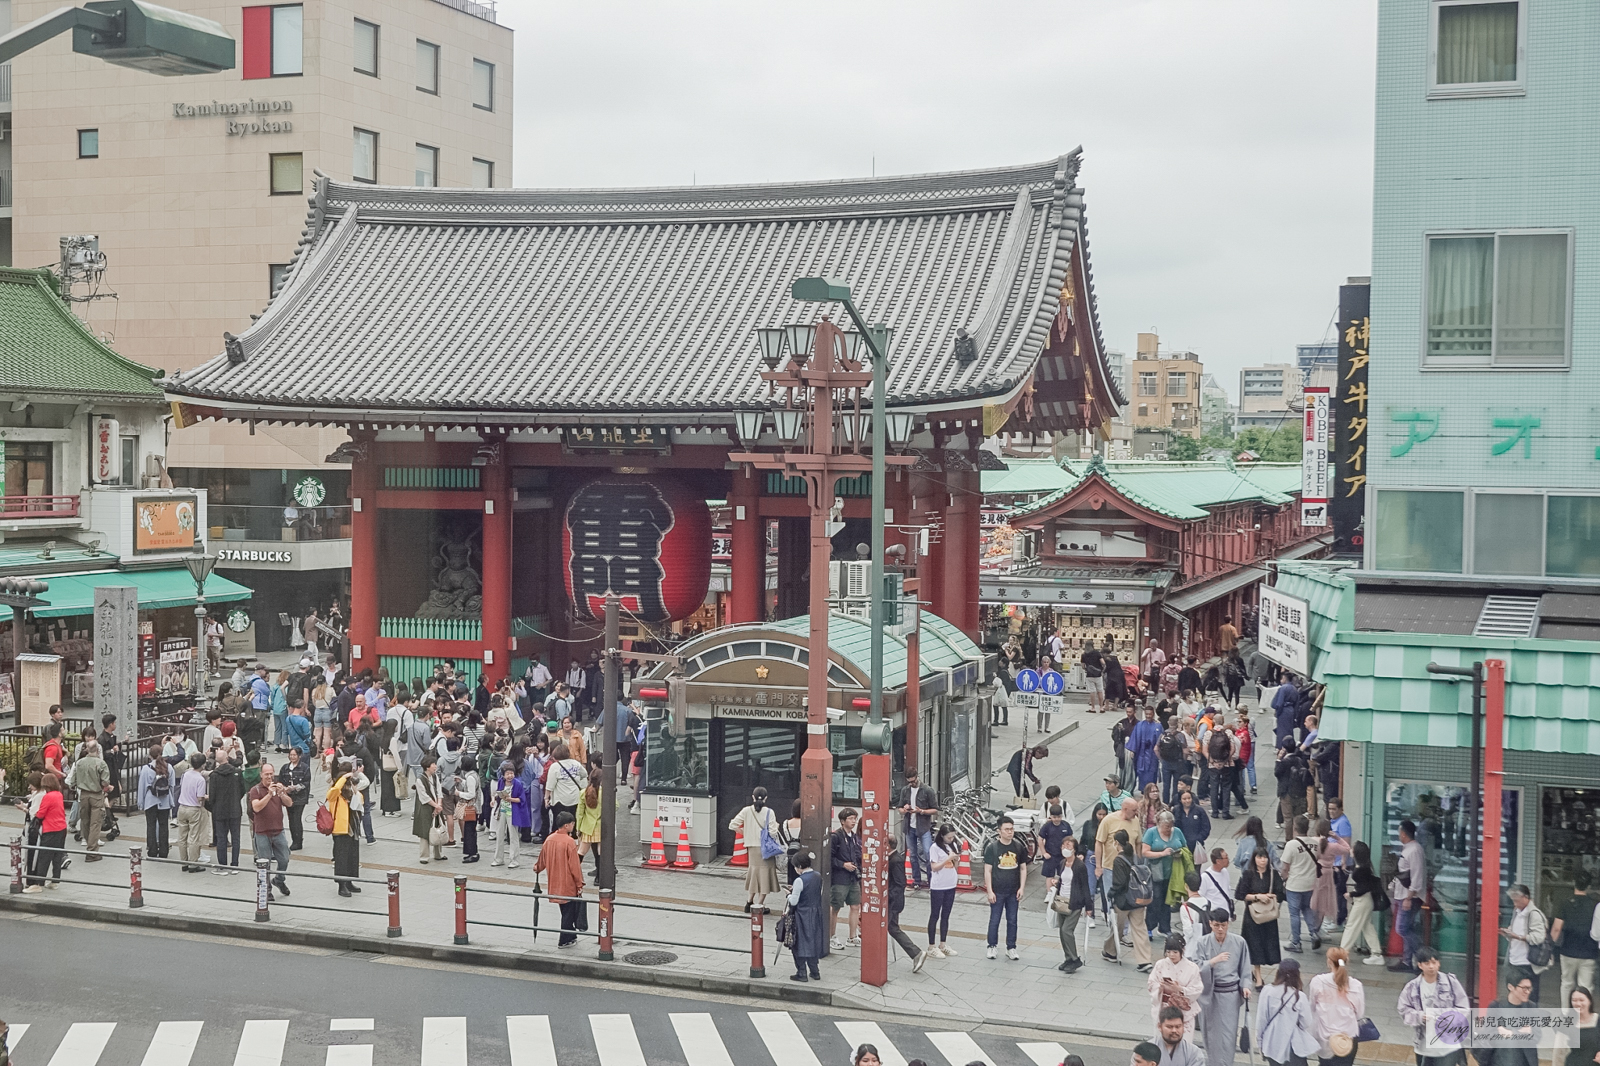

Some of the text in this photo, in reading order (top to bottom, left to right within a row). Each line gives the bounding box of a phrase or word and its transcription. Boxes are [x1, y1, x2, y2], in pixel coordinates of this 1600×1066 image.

[172, 97, 293, 118] Kaminarimon
[226, 118, 293, 137] Ryokan
[1390, 411, 1600, 460] アオ
[1316, 396, 1328, 496] KOBE BEEF
[218, 549, 292, 562] STARBUCKS
[567, 482, 676, 623] 雷門
[1058, 590, 1115, 602] 表参道
[755, 691, 809, 706] 雷門交
[722, 707, 808, 719] KAMINARIMON KOBA
